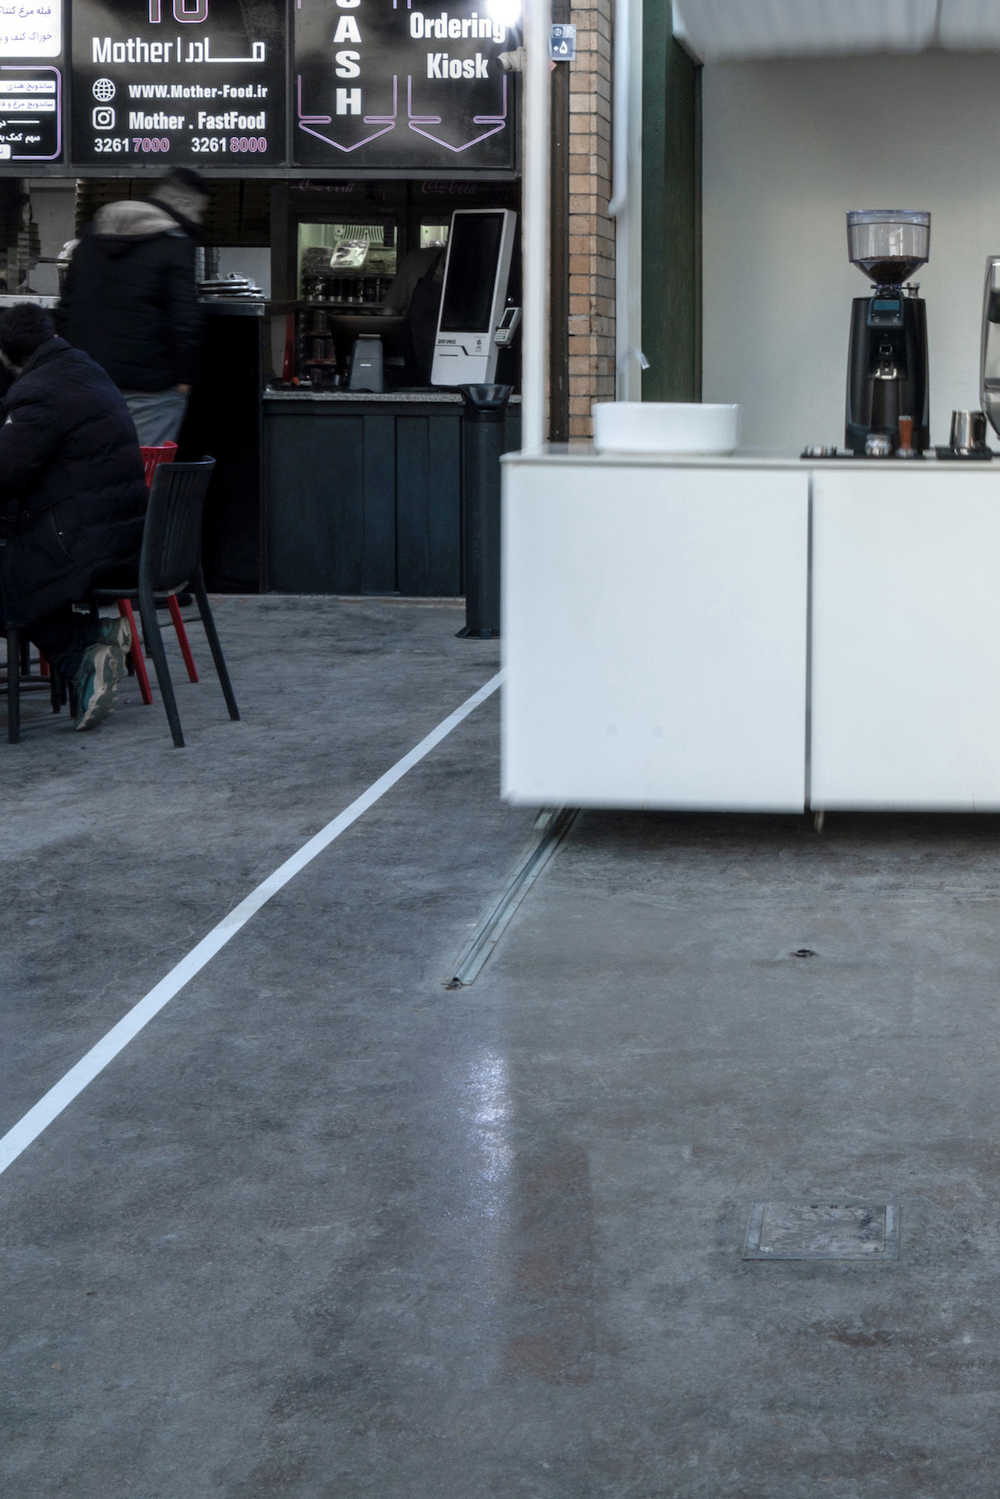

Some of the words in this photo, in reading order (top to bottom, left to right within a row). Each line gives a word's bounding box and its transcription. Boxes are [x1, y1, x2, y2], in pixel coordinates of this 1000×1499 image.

[18, 4, 35, 19] مرغ
[410, 12, 506, 44] Ordering
[92, 37, 173, 63] Mother
[552, 40, 569, 55] ۰۵
[426, 52, 489, 79] Kiosk
[128, 84, 268, 99] WWW.Mother-Food.ir
[129, 111, 185, 130] Mother
[198, 111, 266, 130] FastFood
